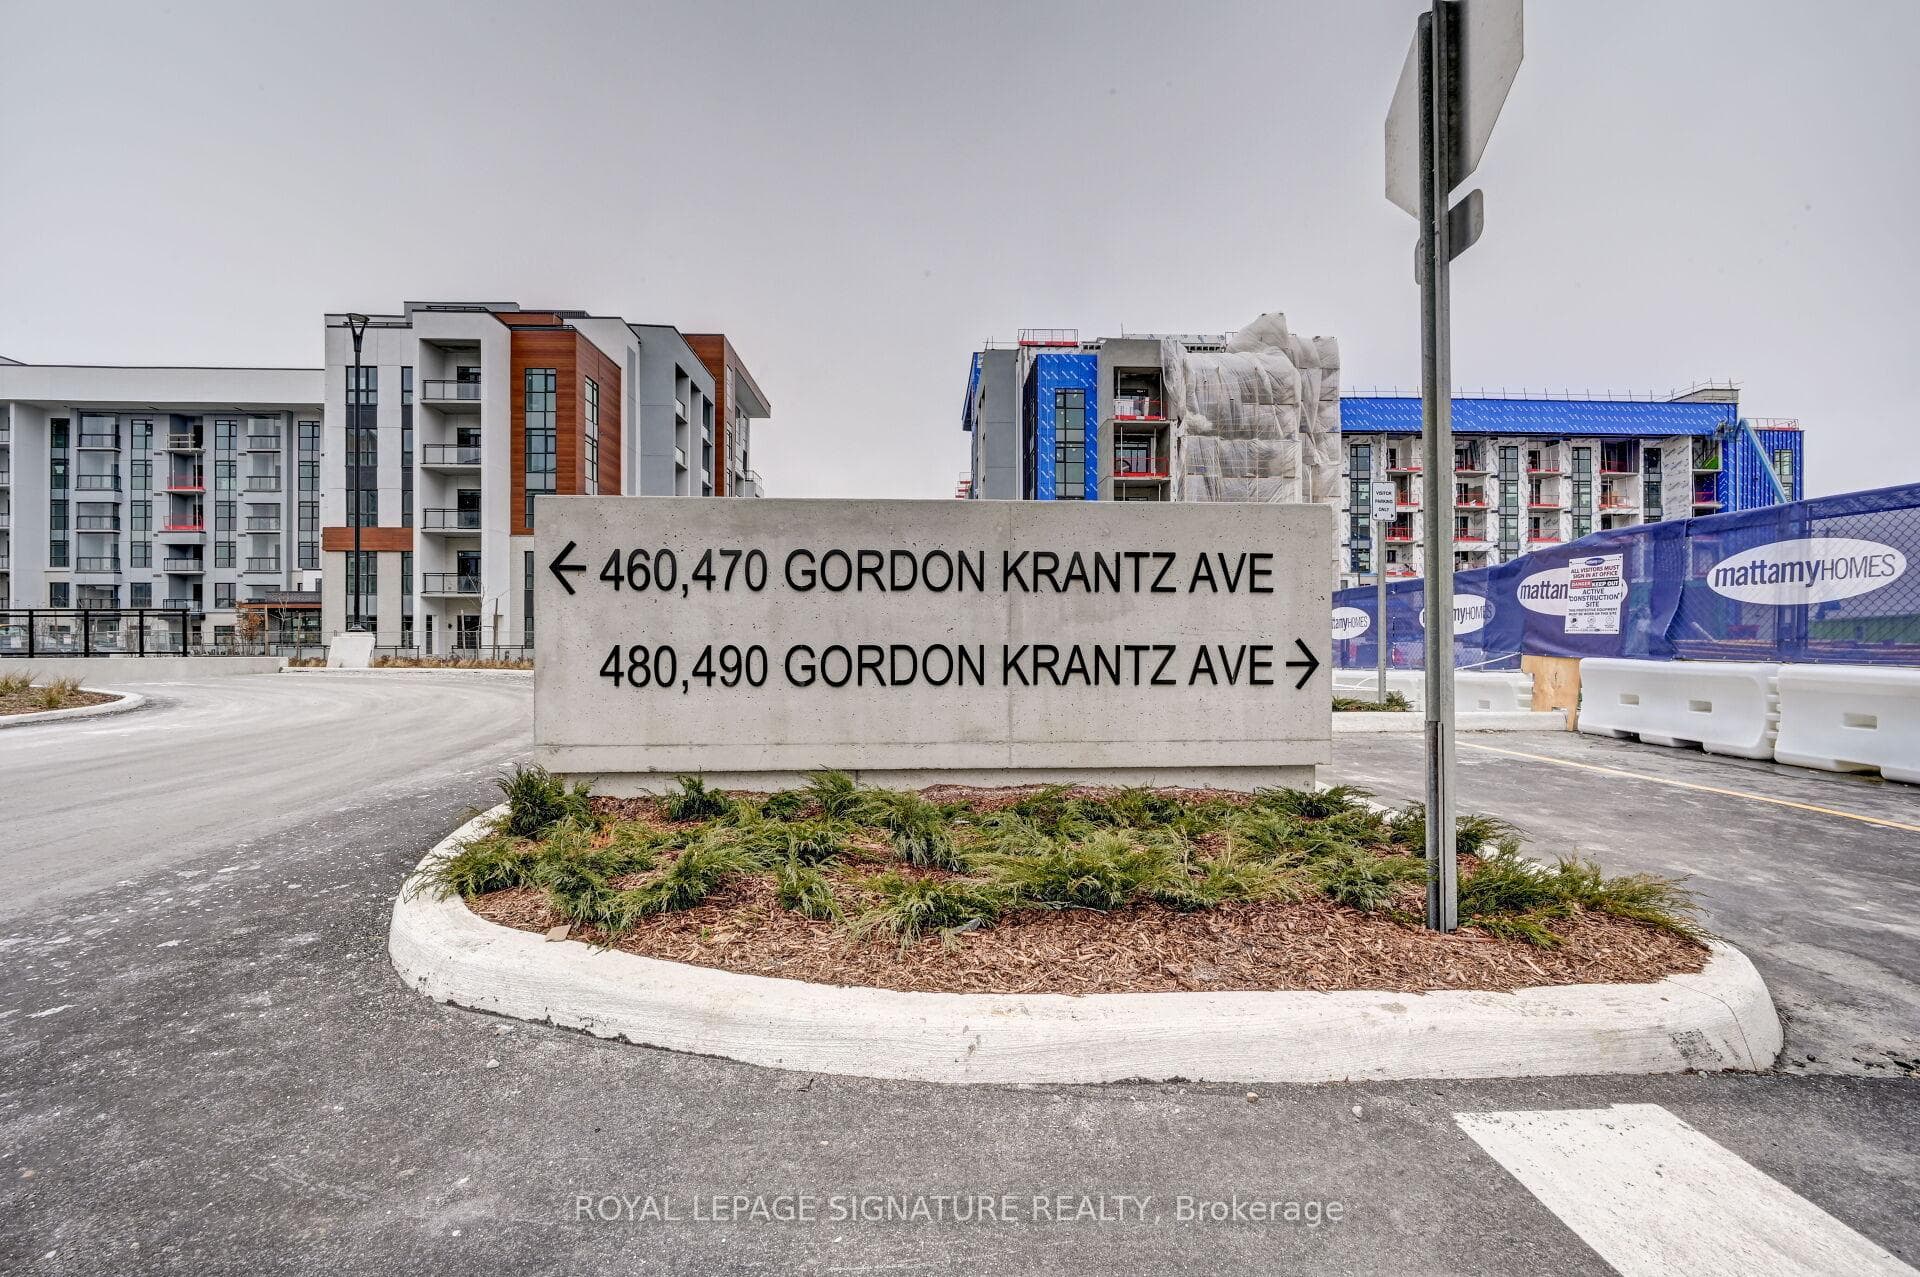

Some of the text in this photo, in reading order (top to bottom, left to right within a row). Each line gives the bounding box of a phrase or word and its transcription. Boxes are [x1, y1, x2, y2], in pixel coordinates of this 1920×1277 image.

[600, 549, 1273, 598] 460,470 GORDON KRANTZ AVE
[1569, 594, 1619, 602] CONSTRUCTION
[600, 644, 1273, 694] 480,490 GORDON KRANTZ AVE
